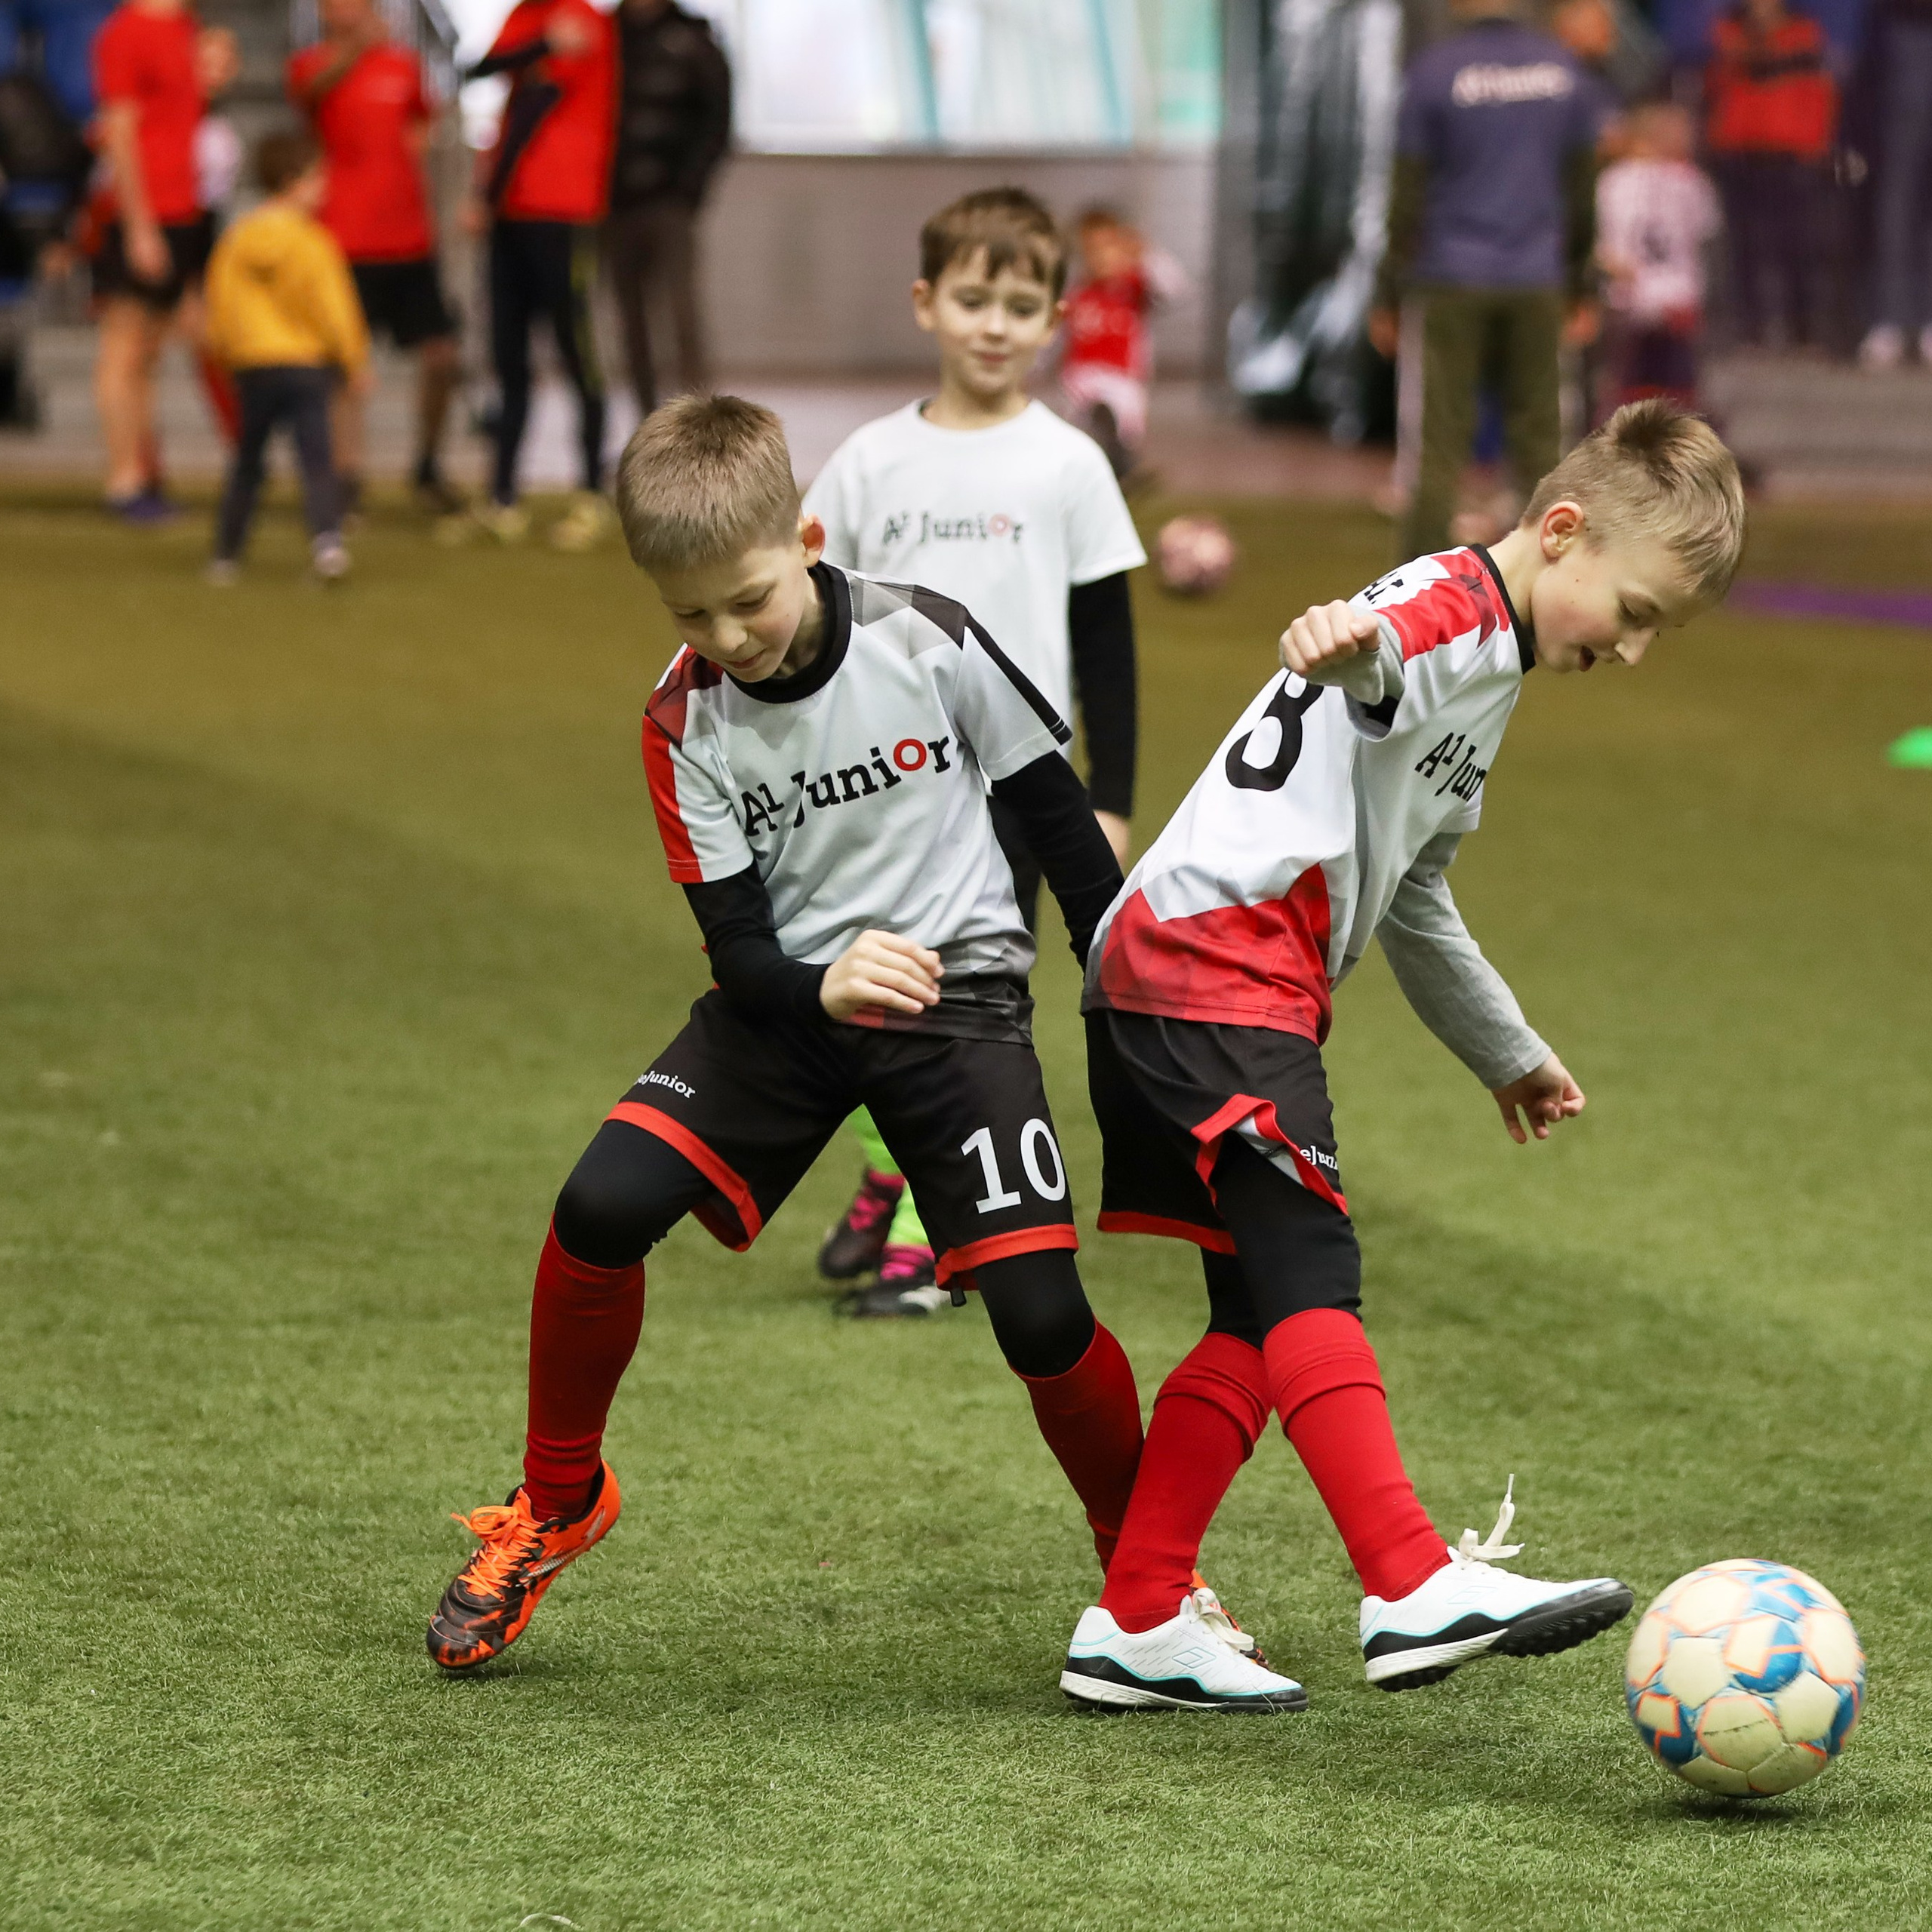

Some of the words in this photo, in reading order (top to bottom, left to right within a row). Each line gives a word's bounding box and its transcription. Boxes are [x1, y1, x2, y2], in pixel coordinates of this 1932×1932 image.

[918, 510, 1023, 545] Junior
[1225, 671, 1324, 792] 8
[740, 782, 785, 837] A1
[790, 735, 951, 829] Junior
[961, 1118, 1066, 1214] 10
